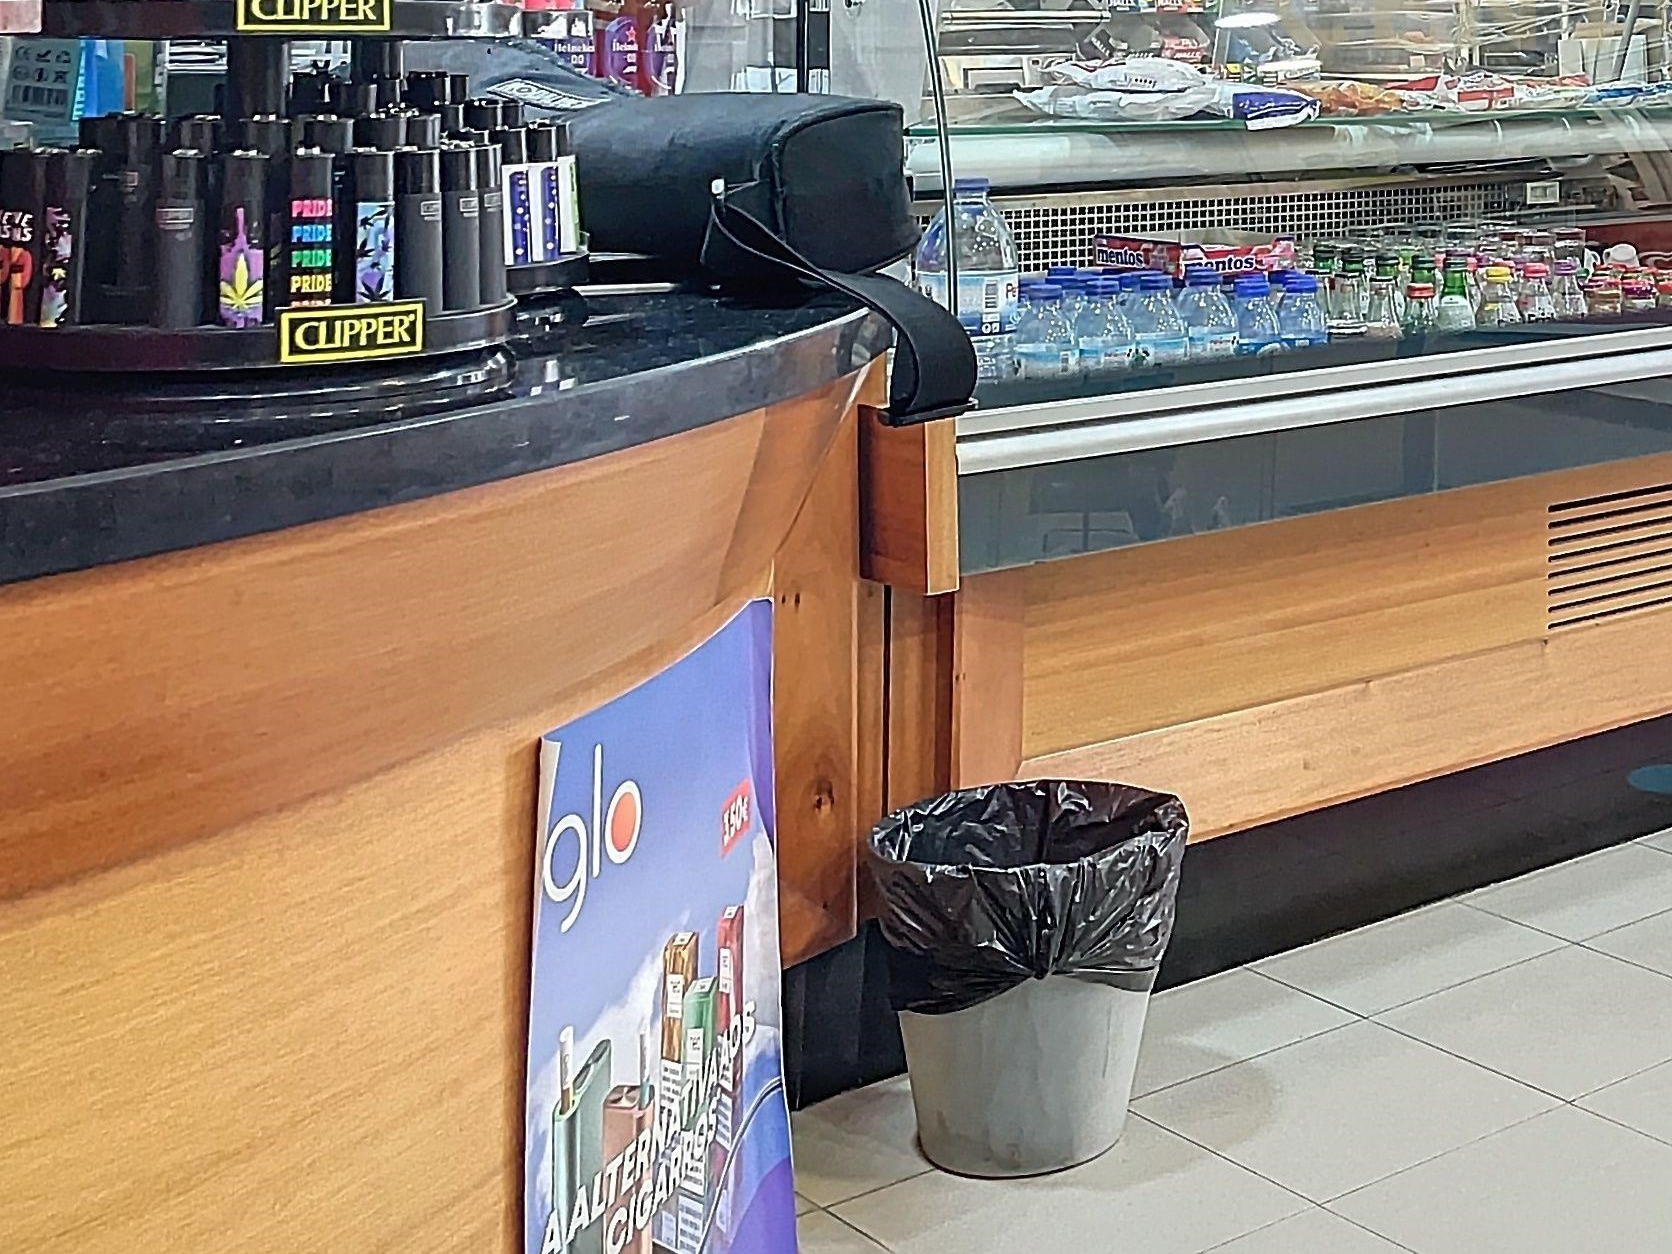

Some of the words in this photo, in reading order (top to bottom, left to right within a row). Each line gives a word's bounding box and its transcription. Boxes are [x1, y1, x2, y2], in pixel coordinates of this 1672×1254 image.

[292, 199, 332, 217] PRIDE
[291, 224, 332, 242] PRIDE
[291, 250, 331, 268] PRIDE
[1098, 247, 1144, 268] mentos
[290, 275, 331, 293] PRIDE
[294, 314, 412, 350] CLIPPER
[543, 742, 642, 934] glo
[540, 1209, 563, 1254] A
[564, 1047, 719, 1246] ALTERNATIVA
